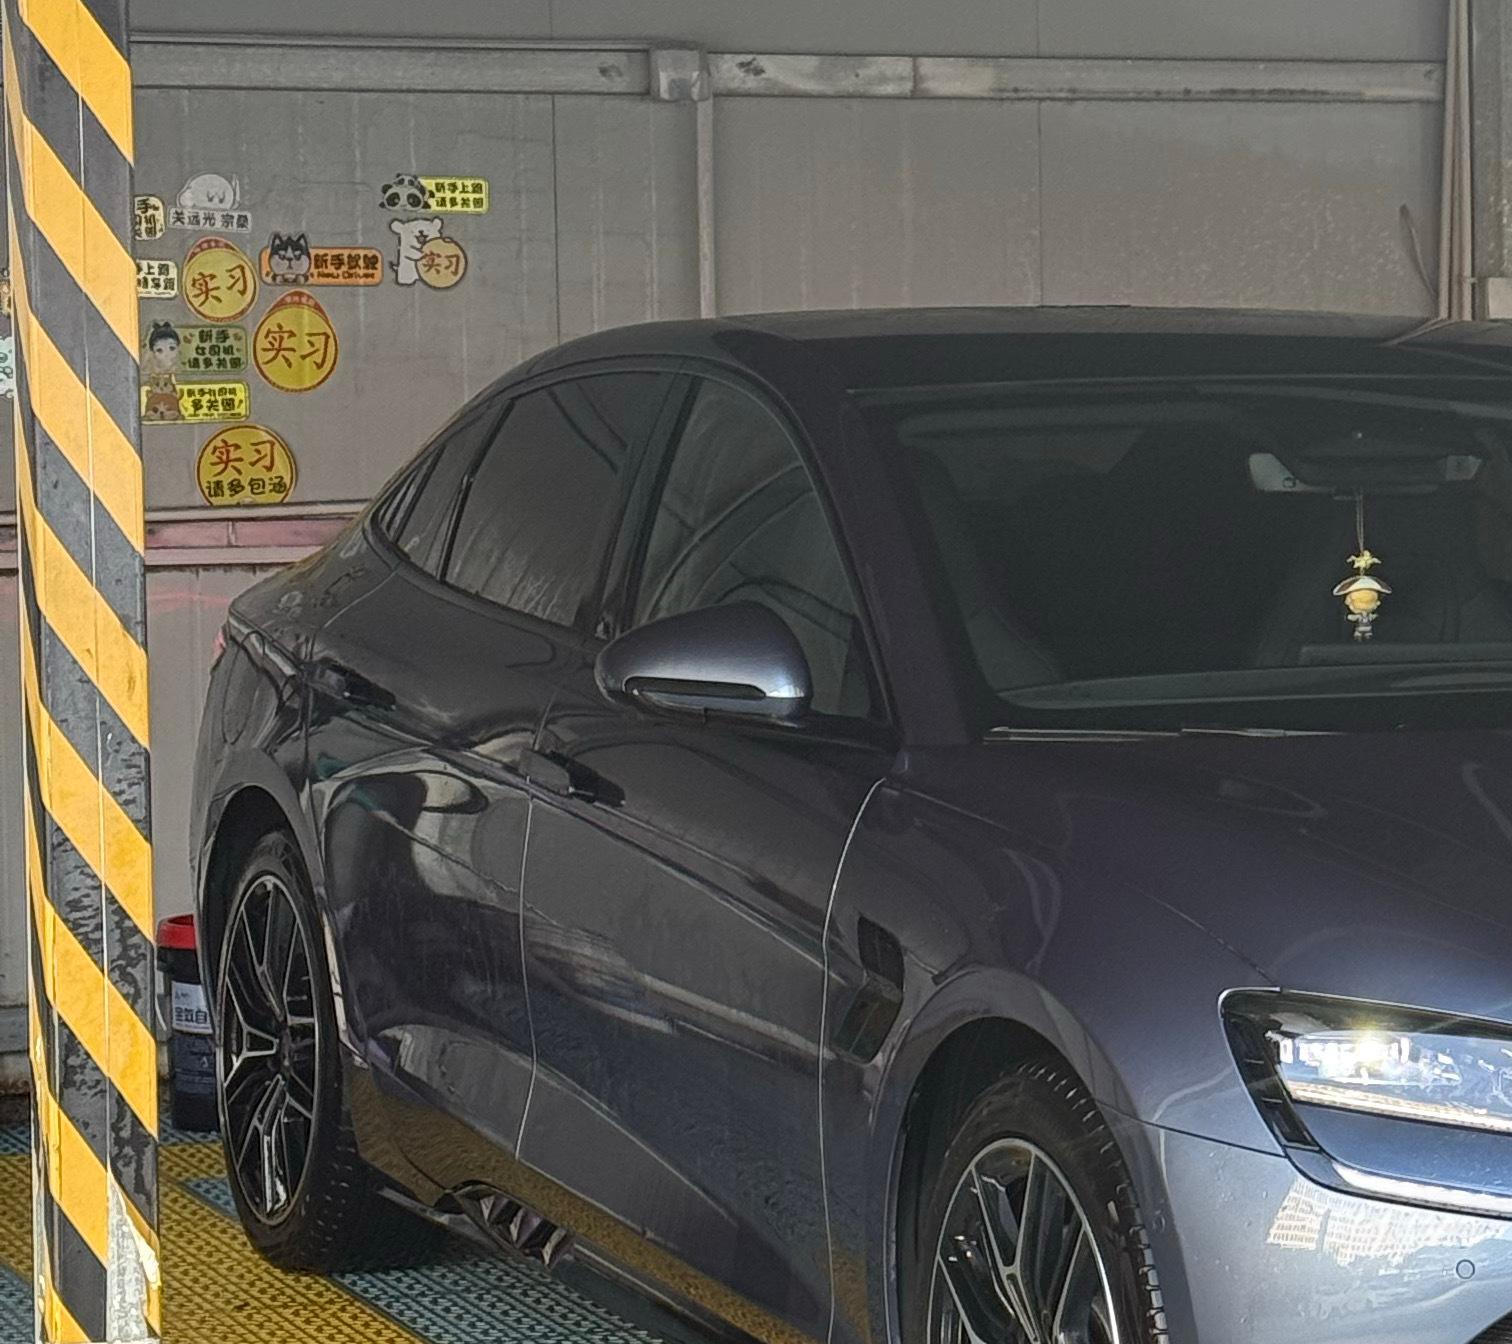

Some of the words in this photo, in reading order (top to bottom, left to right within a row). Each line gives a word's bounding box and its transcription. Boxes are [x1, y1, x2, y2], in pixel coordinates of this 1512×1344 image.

[435, 181, 483, 194] 新手上路
[435, 196, 484, 209] 请多关照
[422, 249, 461, 277] 实习
[191, 262, 248, 308] 实习
[198, 328, 230, 344] 新手
[261, 322, 331, 371] 实习
[187, 356, 242, 370] 请多关照
[210, 438, 276, 477] 实习
[205, 475, 287, 498] 请多包涵
